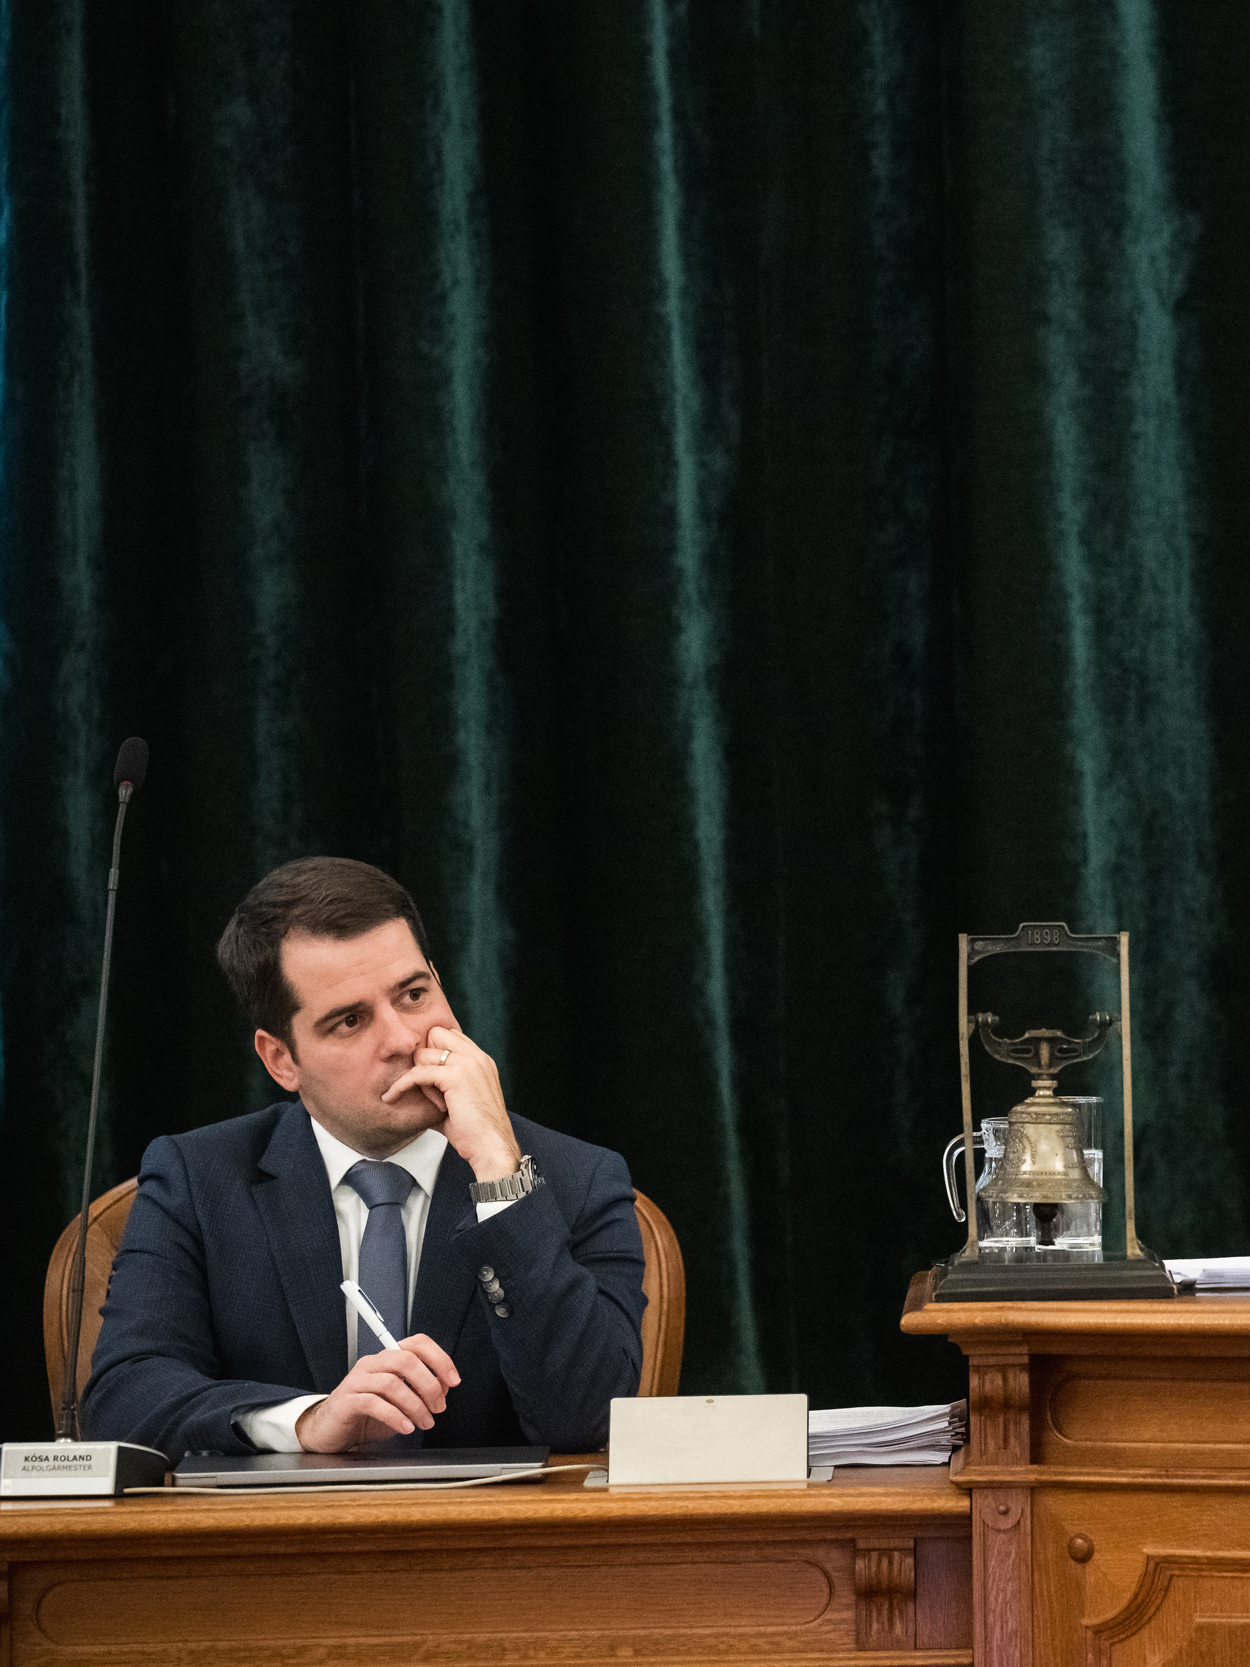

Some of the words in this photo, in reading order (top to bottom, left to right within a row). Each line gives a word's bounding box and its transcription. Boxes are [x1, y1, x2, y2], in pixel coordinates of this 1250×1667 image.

[1027, 929, 1060, 944] 1898
[24, 1453, 50, 1462] KÓSA
[53, 1454, 93, 1462] ROLAND
[22, 1463, 93, 1472] ALPOLGÁRMESTER
